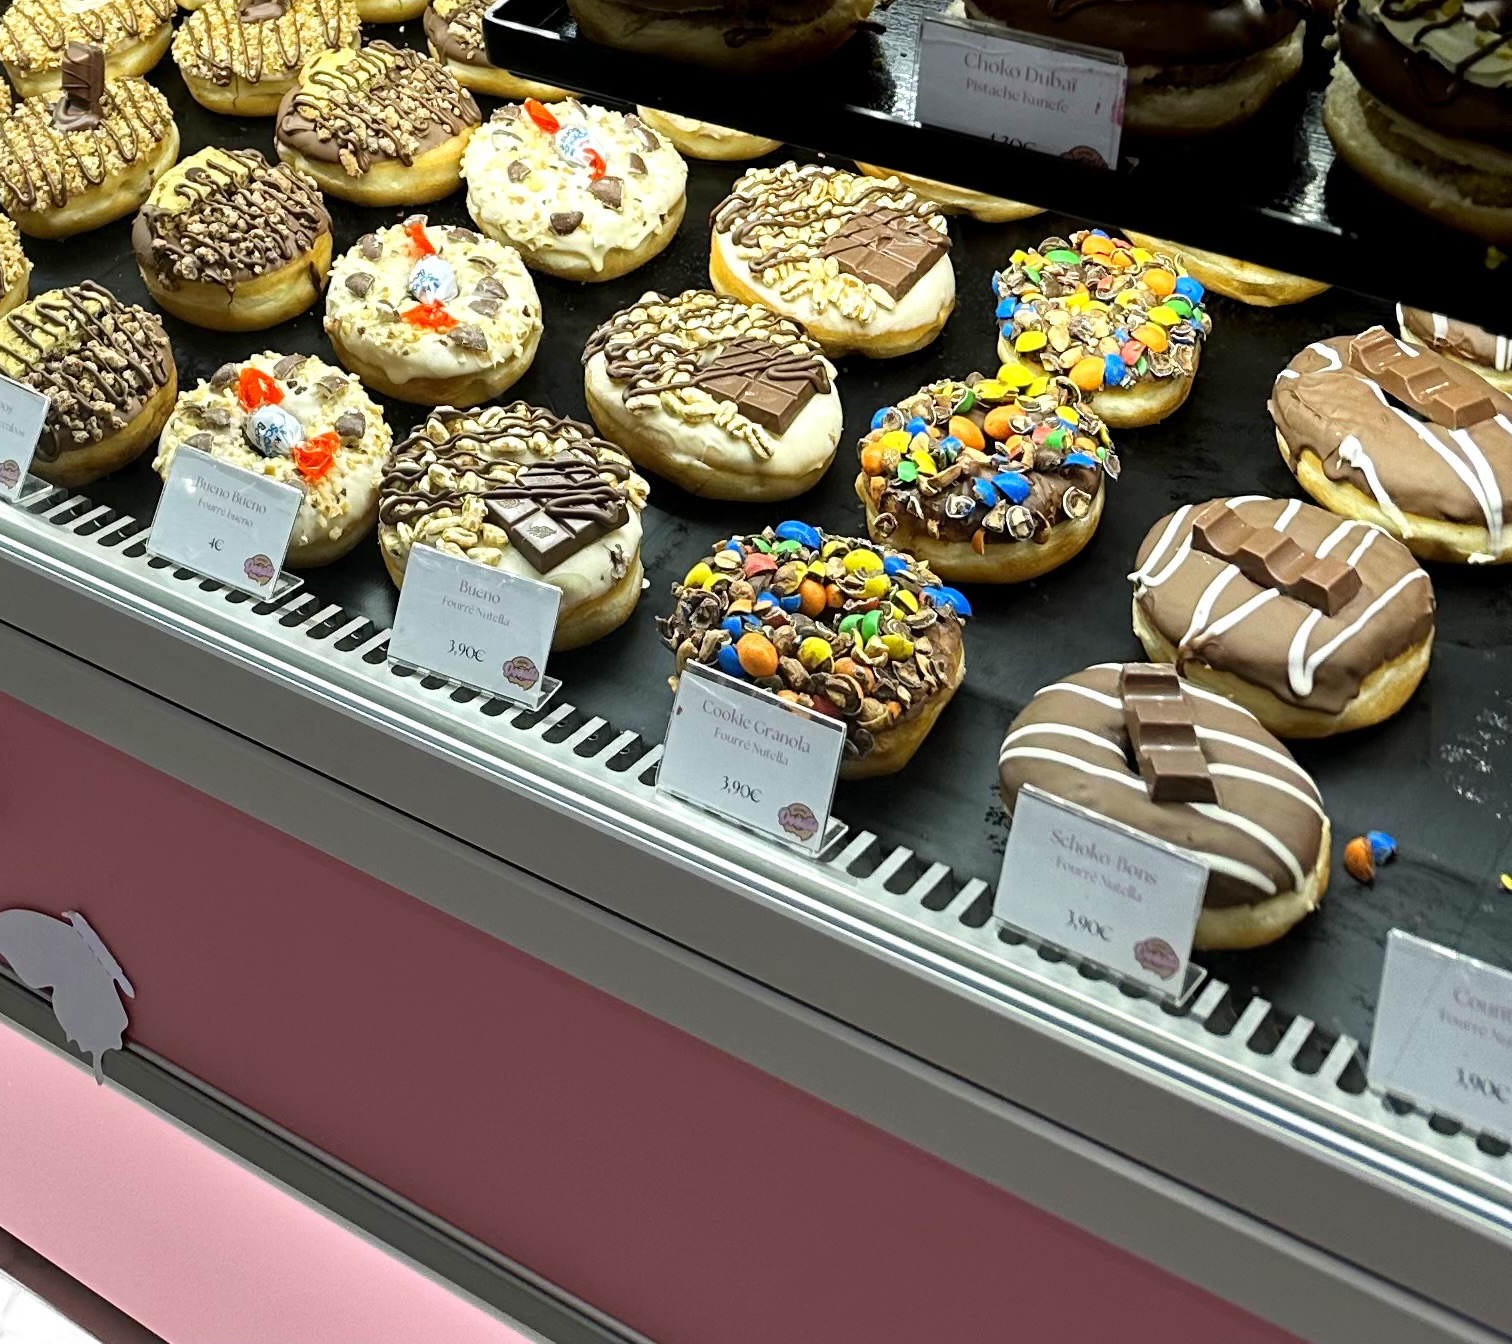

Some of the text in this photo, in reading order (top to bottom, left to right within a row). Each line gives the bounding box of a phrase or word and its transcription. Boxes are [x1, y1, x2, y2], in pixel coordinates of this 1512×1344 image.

[964, 51, 1078, 93] Choko Dubaï
[965, 78, 1021, 104] Pistache
[196, 476, 267, 515] Bueno Bueno
[459, 579, 501, 604] Bueno
[442, 595, 511, 627] Fourré Nutella
[448, 639, 486, 663] 3,90€
[702, 699, 811, 754] Cookie Granola
[713, 726, 790, 766] Fourré Nutella
[721, 775, 763, 803] 3,90€
[1050, 829, 1158, 886] Schoko Bons
